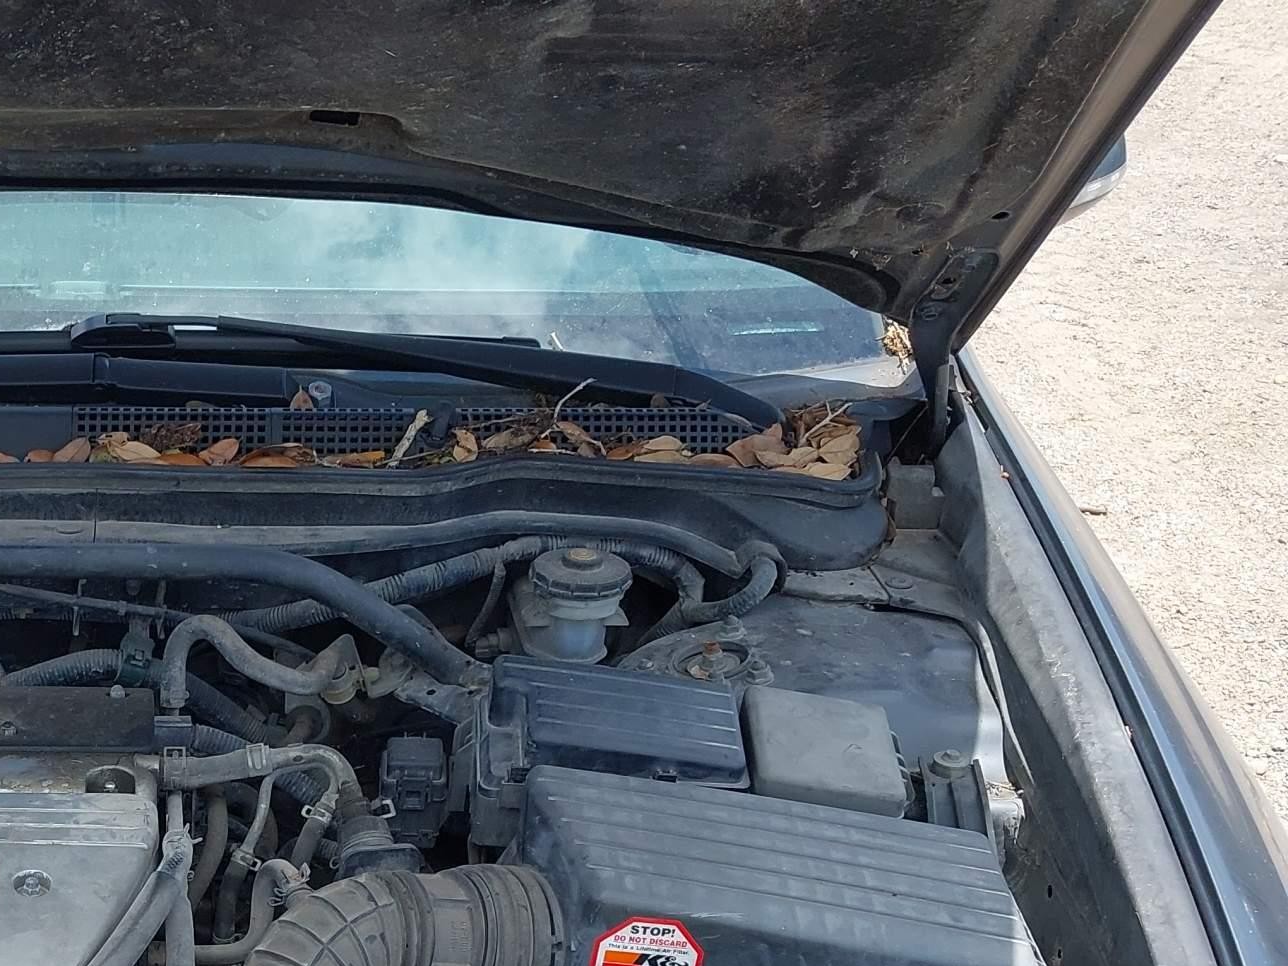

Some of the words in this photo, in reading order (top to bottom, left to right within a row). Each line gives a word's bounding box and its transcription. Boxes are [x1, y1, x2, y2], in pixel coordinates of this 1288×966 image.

[630, 925, 676, 938] STOP!
[628, 936, 647, 944] NOT
[649, 939, 688, 948] DISCARD
